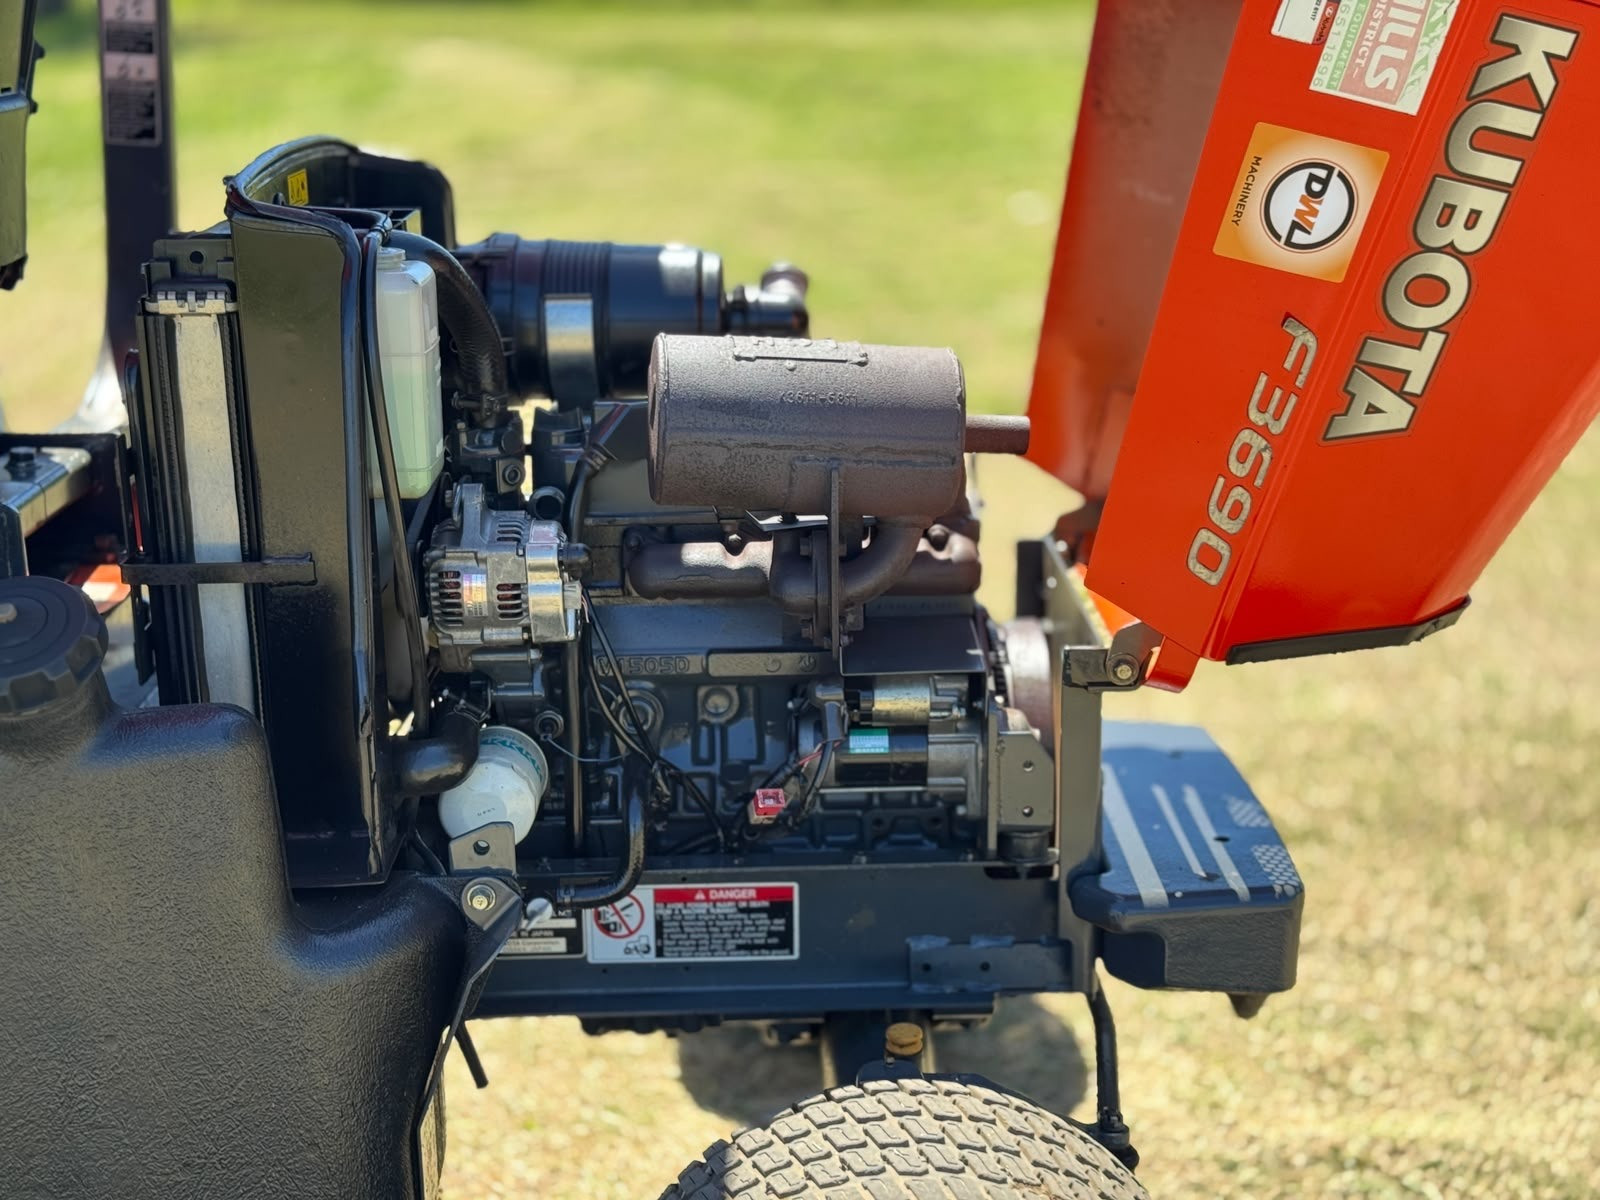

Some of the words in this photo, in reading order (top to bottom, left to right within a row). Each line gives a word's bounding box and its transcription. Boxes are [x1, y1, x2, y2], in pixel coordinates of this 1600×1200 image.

[1329, 3, 1368, 90] EQUIPMENT
[1231, 155, 1263, 227] MACHINERY
[1281, 165, 1336, 249] DWL
[1322, 13, 1580, 441] KUBOTA
[1186, 315, 1318, 587] F3690
[709, 889, 757, 900] DANGER
